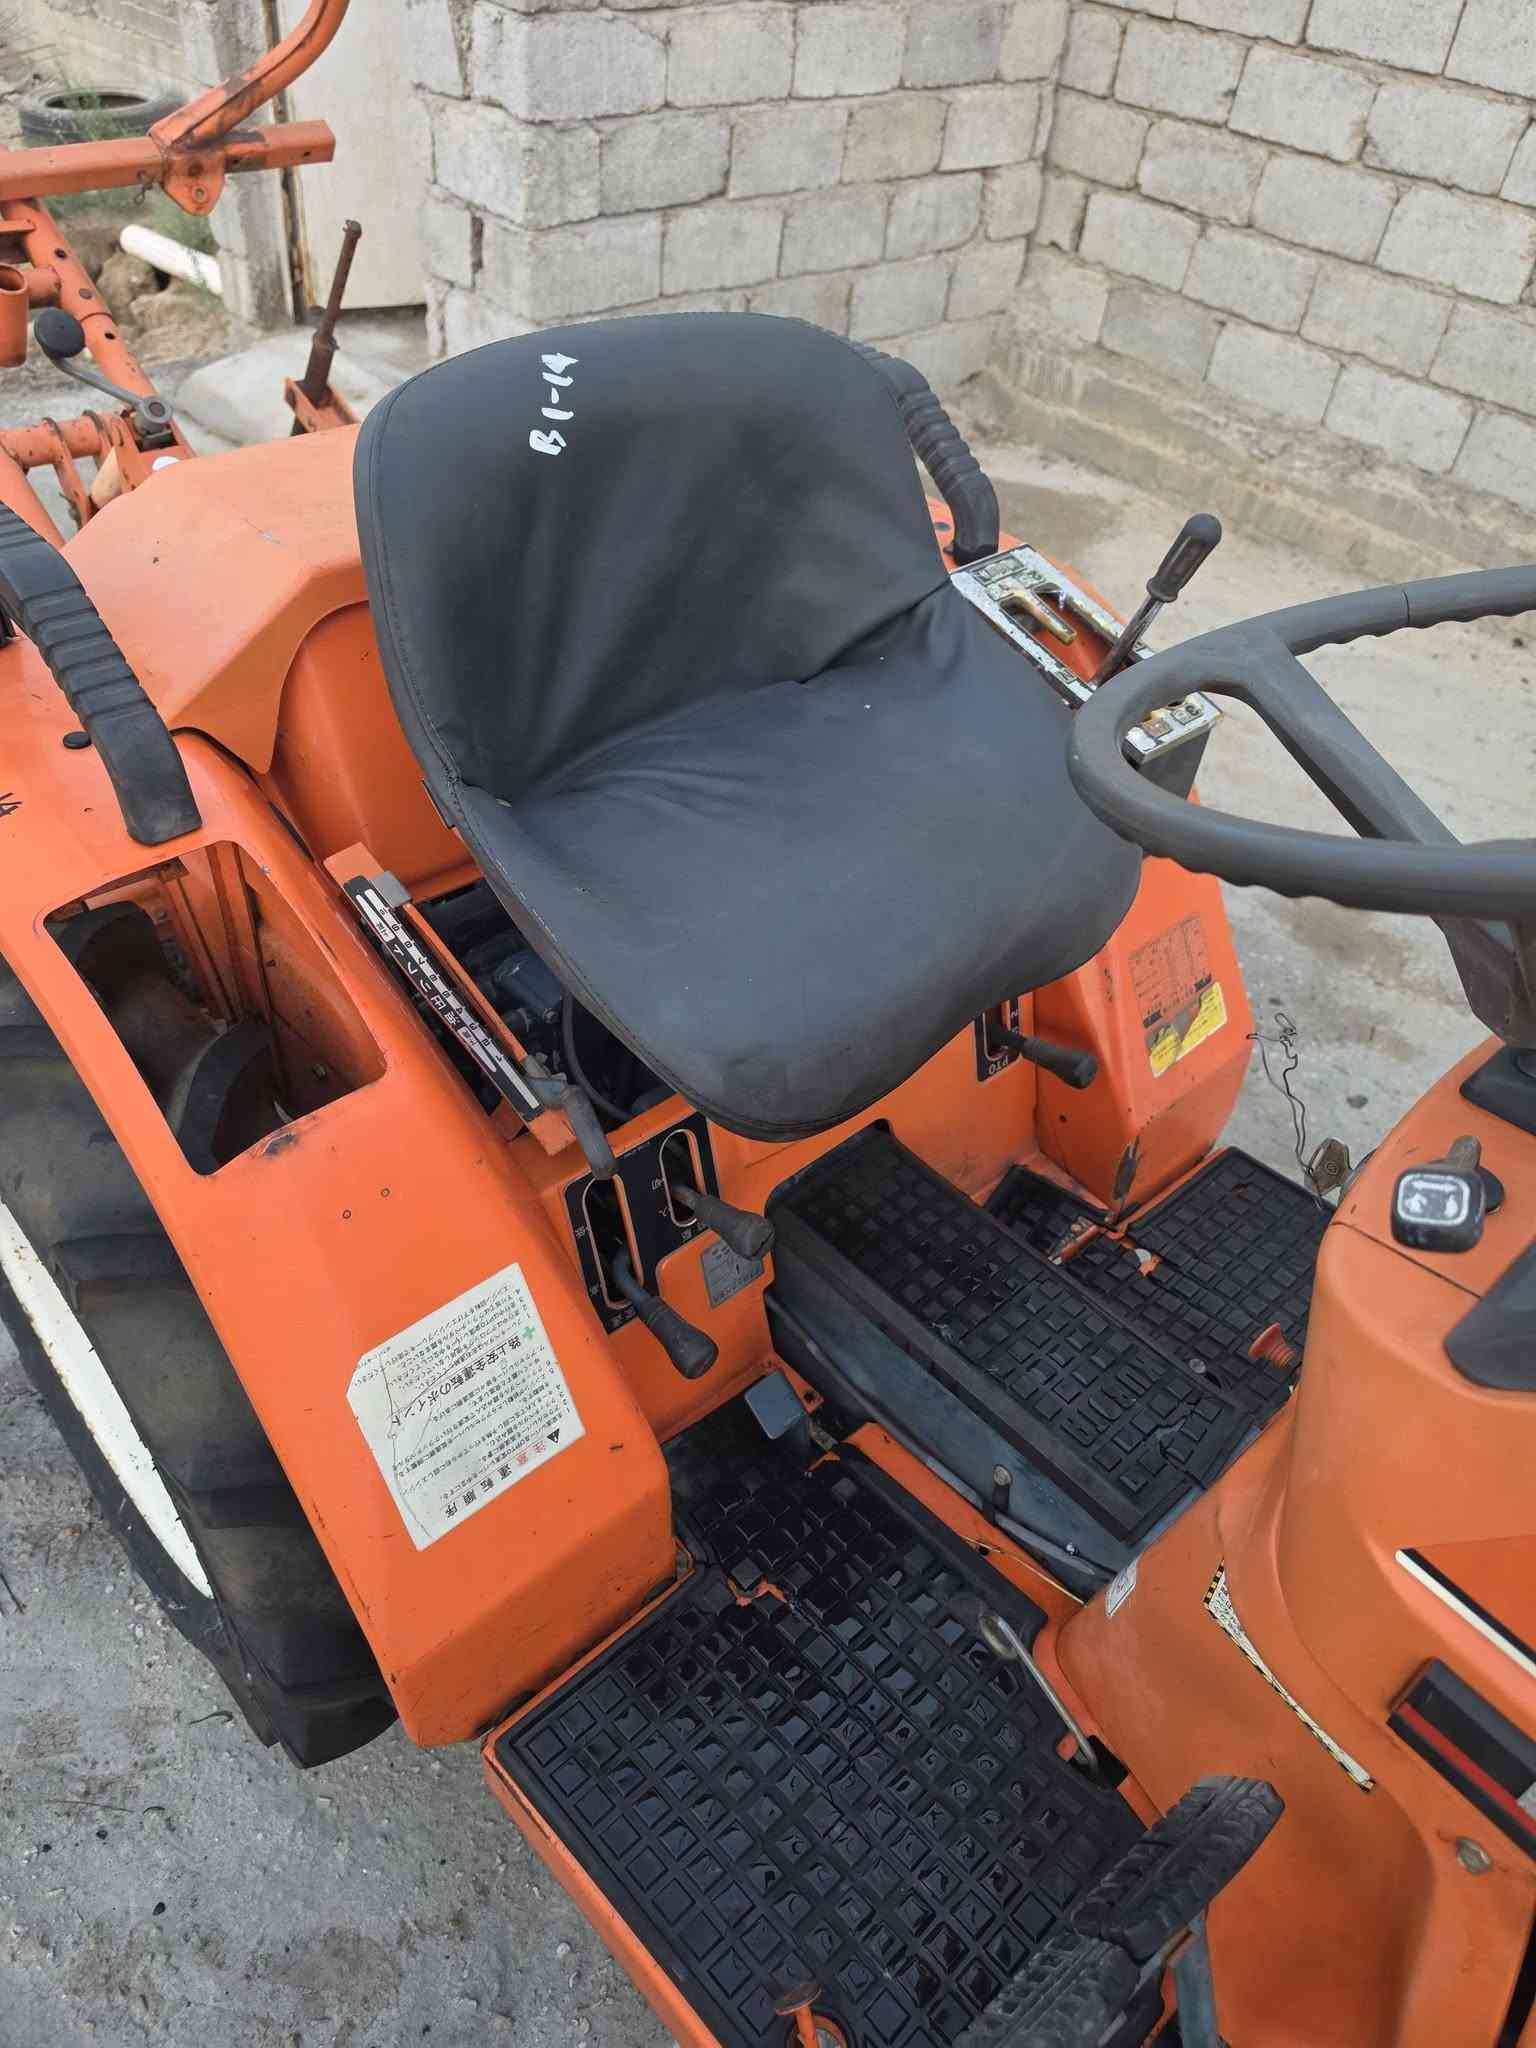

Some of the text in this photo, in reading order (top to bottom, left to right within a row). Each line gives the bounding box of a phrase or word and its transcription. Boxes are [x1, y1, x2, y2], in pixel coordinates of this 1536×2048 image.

[392, 944, 463, 1025] 油圧リフト
[988, 1056, 1009, 1074] PTO
[390, 1334, 521, 1428] 路上安全運転のポイント
